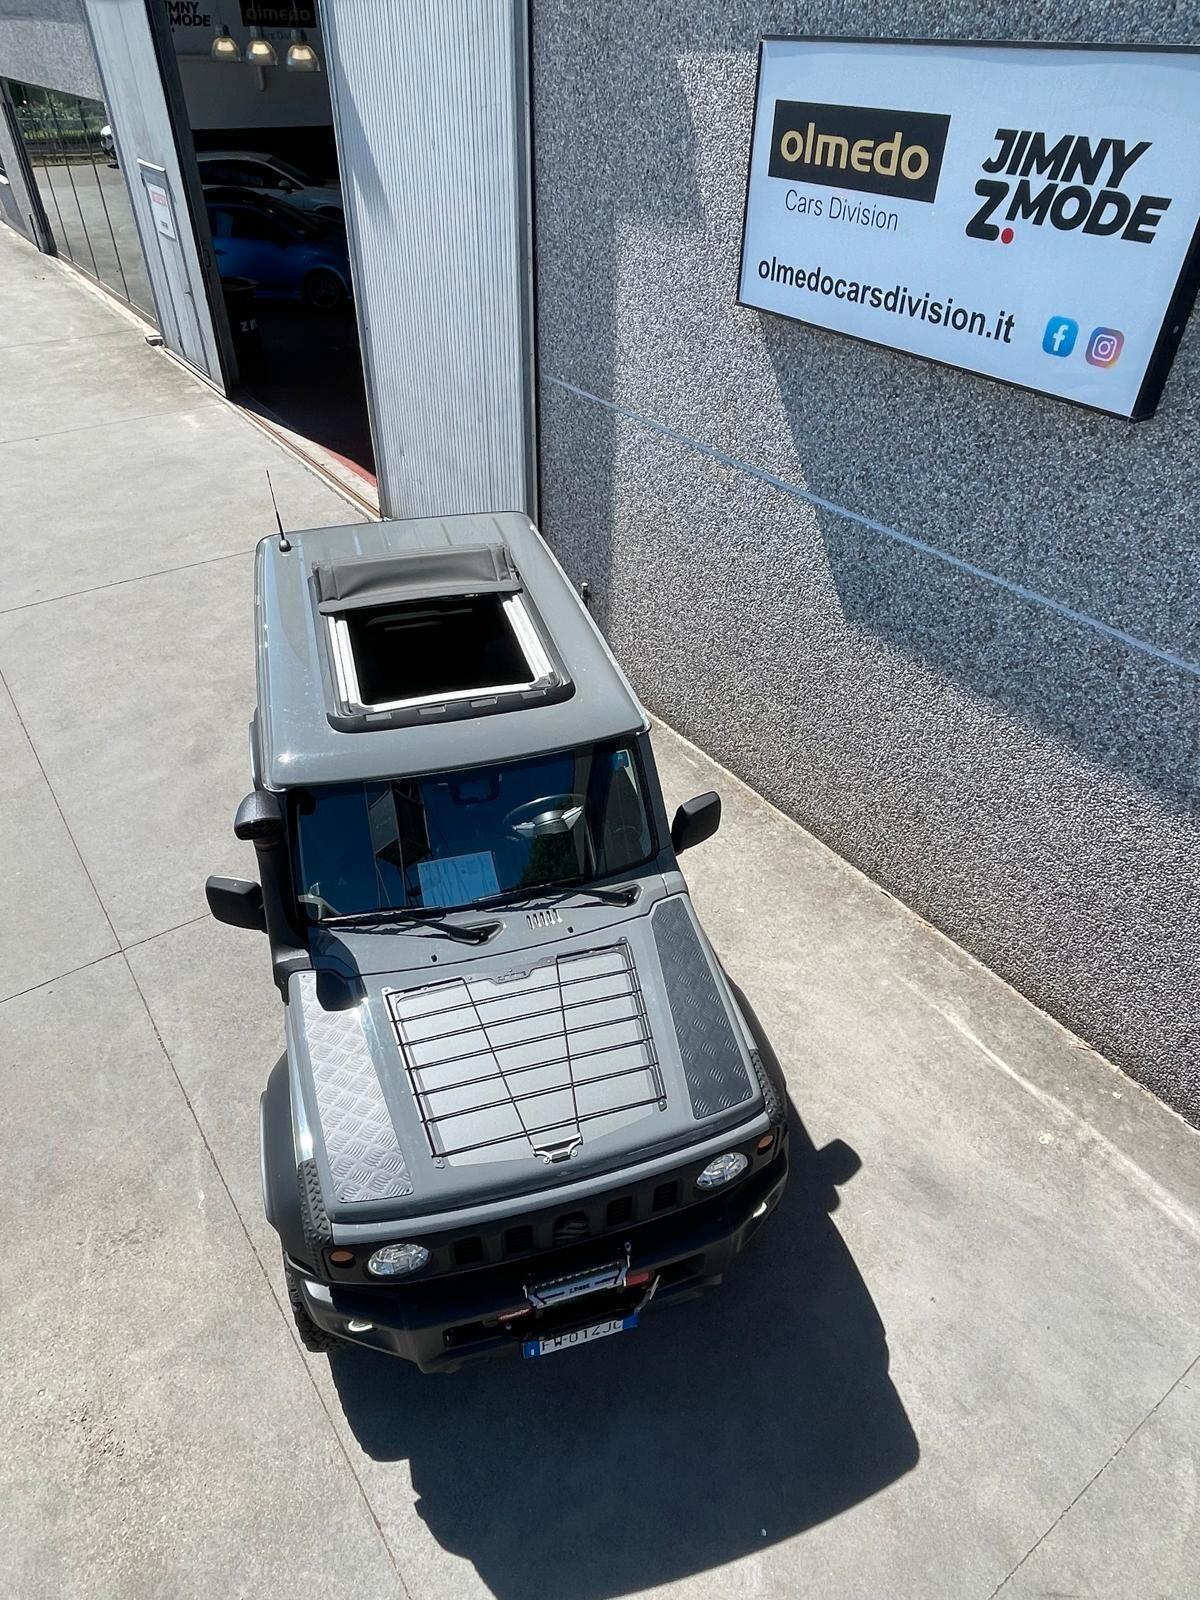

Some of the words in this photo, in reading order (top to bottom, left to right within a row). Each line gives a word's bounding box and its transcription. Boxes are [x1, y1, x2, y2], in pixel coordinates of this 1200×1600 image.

[780, 121, 930, 181] olmedo
[981, 127, 1153, 188] JIMNY
[785, 189, 823, 218] Cars
[828, 195, 899, 232] Division
[757, 256, 1017, 344] olmedocarsdivision.it
